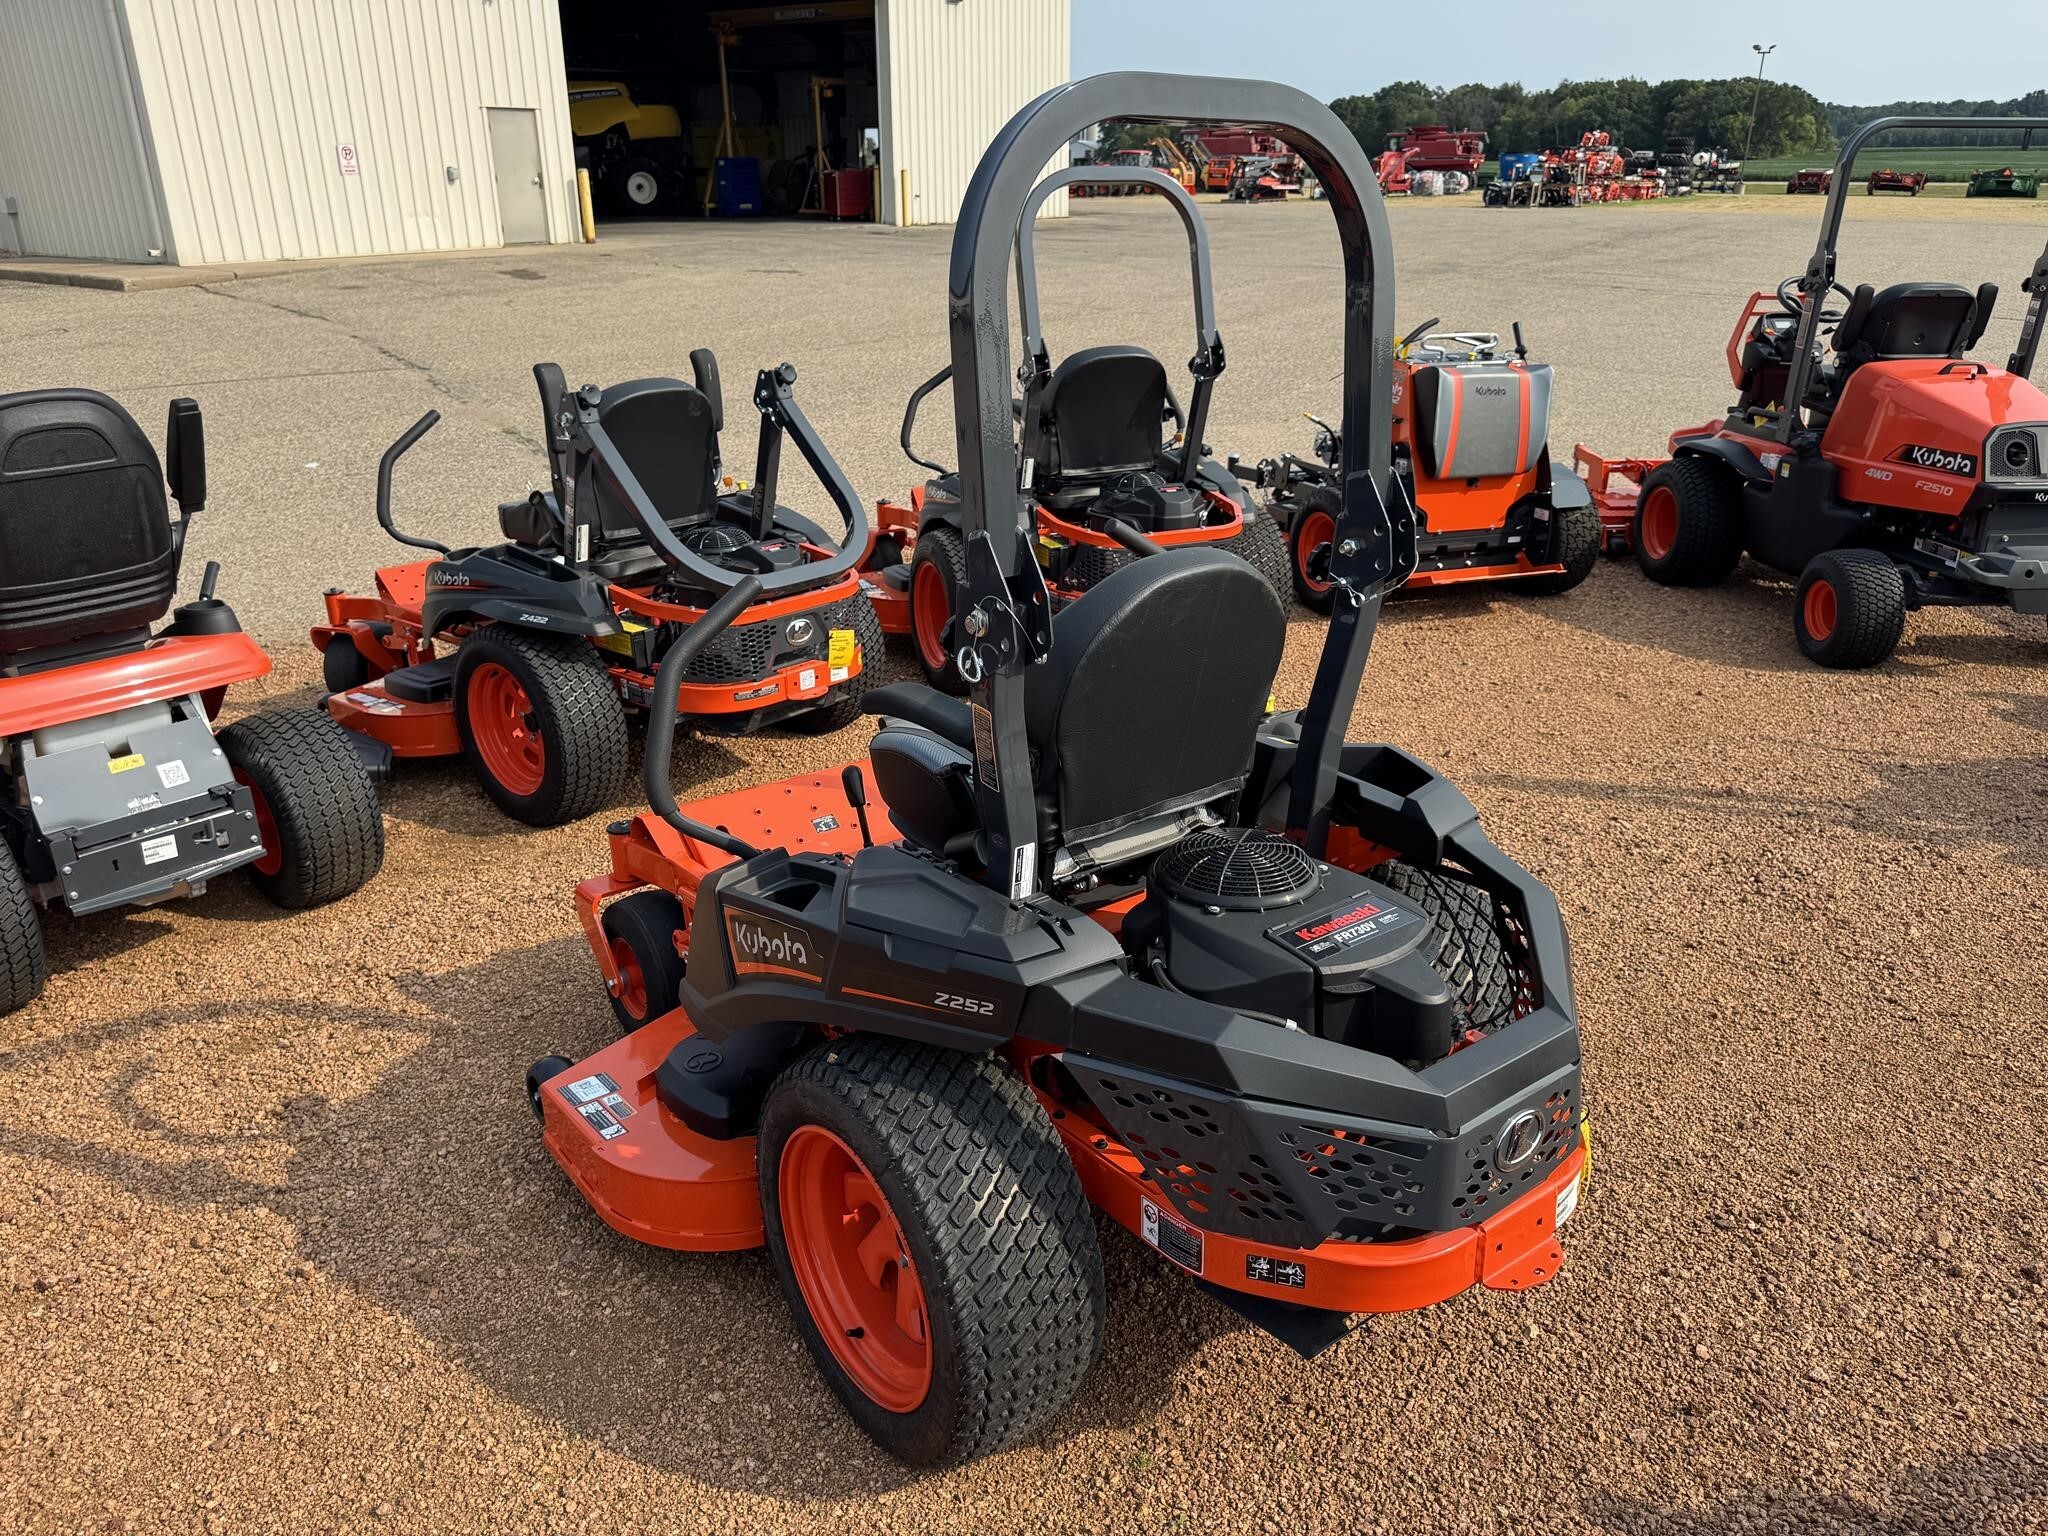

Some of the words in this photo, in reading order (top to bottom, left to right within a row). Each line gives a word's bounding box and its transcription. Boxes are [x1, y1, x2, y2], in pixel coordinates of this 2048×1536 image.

[1475, 385, 1506, 396] Kubota
[1912, 446, 1971, 473] Kubota
[1864, 467, 1893, 481] 4WD
[1914, 480, 1954, 496] F2510
[434, 570, 470, 586] Kubota
[520, 613, 549, 624] Z422
[1295, 903, 1382, 941] Kawasaki
[1333, 920, 1377, 943] FR730V
[734, 921, 807, 965] Kubota
[934, 991, 995, 1016] Z252
